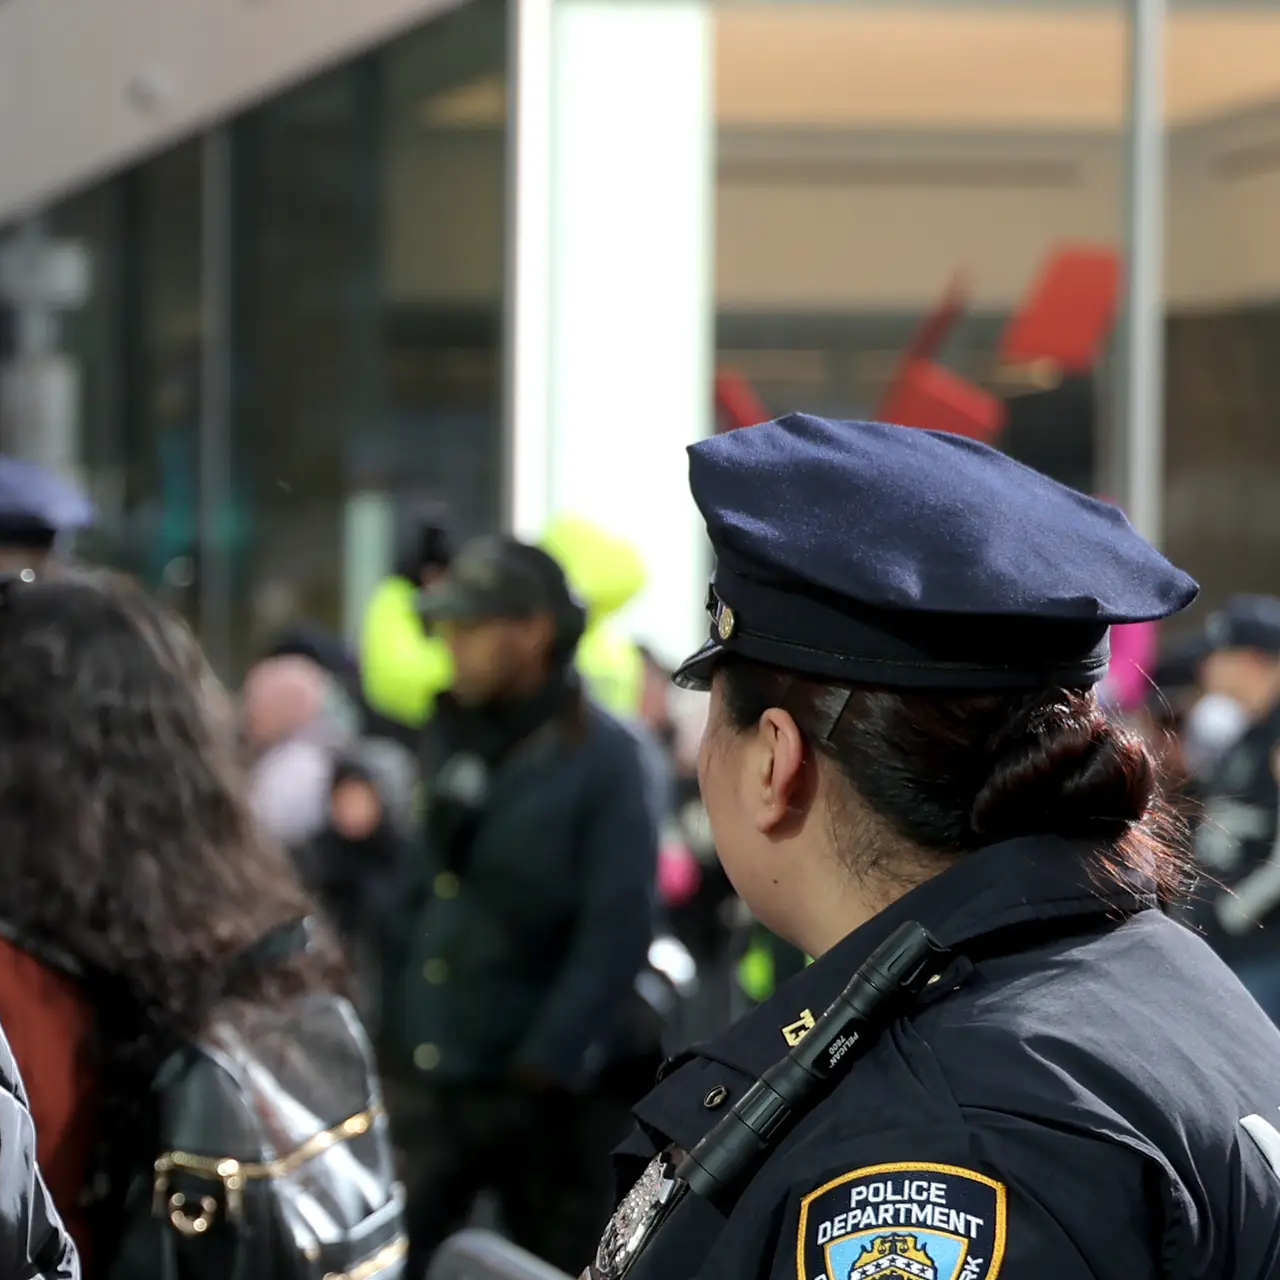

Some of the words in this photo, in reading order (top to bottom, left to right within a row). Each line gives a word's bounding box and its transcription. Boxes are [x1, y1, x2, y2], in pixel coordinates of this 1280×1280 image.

[829, 1031, 859, 1066] PELICAN
[850, 1180, 947, 1208] POLICE
[817, 1203, 984, 1246] DEPARTMENT
